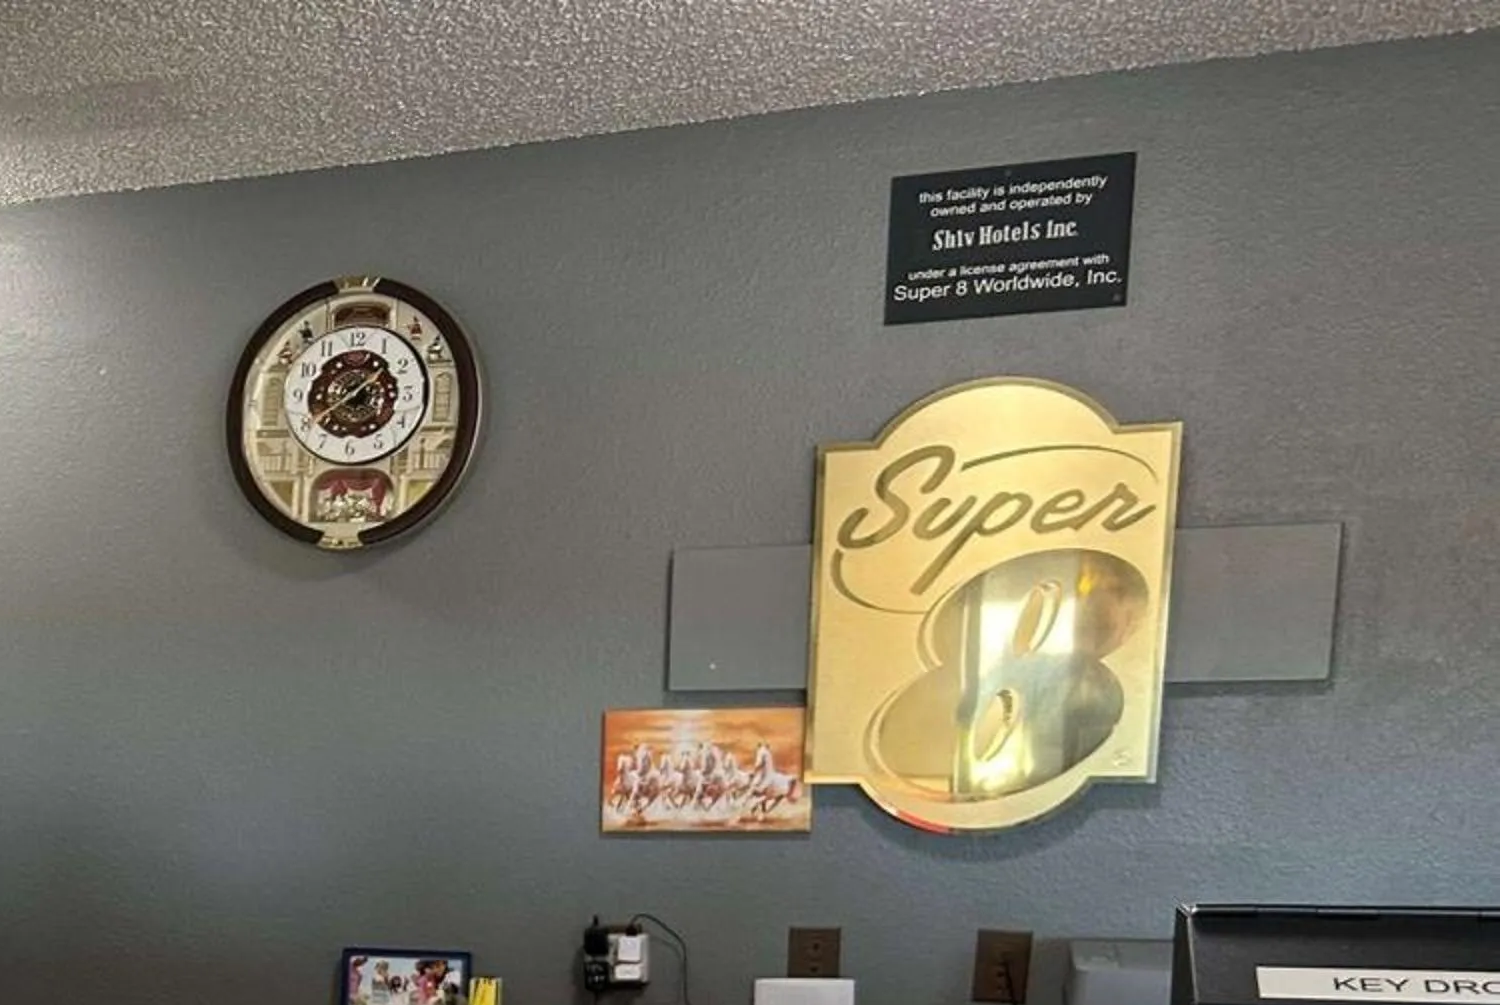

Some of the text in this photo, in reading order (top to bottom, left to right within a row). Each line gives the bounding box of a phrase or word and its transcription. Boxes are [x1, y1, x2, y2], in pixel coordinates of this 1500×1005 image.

[919, 175, 1108, 204] this facility is independently
[930, 191, 1093, 218] owned and operated by
[979, 221, 1041, 246] Hotels
[908, 253, 1109, 281] under a license agreement with
[894, 269, 1122, 303] Super 8 Worldwide, Inc.
[350, 332, 366, 347] 12
[302, 362, 317, 378] 10
[293, 389, 303, 403] 9
[345, 441, 355, 456] 6
[836, 444, 1158, 597] Super
[862, 547, 1151, 804] 8
[1333, 976, 1408, 993] KEY
